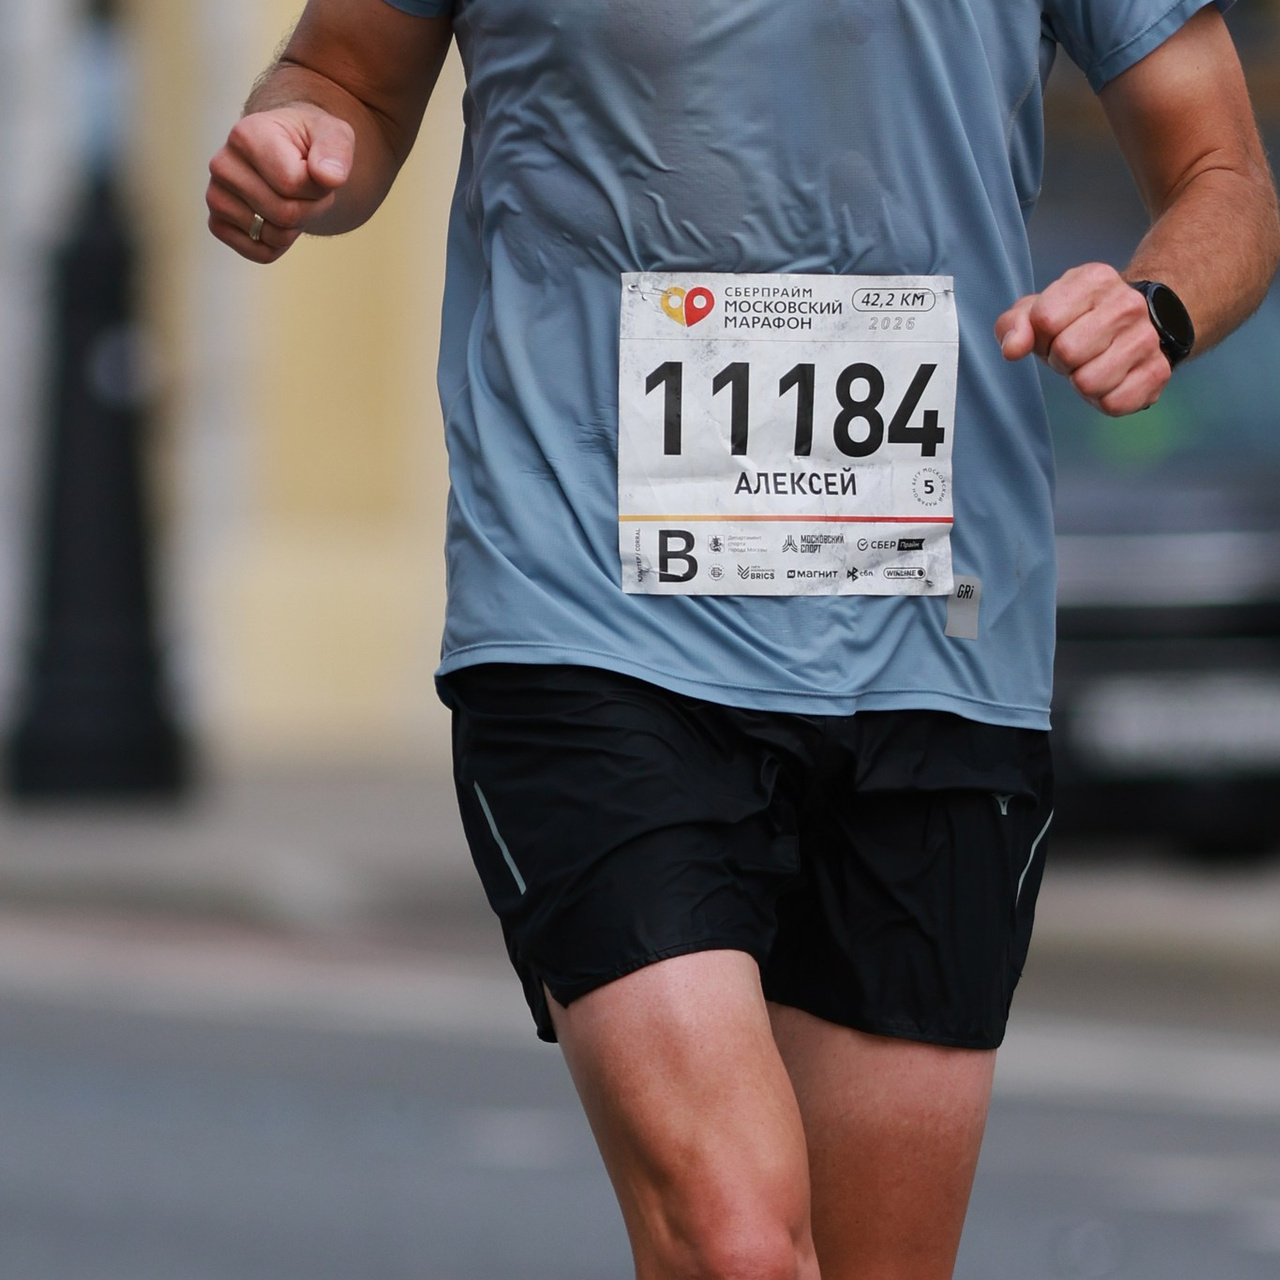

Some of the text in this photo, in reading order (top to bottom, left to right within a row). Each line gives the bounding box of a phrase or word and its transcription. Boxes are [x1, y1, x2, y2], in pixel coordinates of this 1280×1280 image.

[724, 286, 813, 298] СБЕРПРАЙМ
[724, 300, 843, 315] МОСКОВСКИЙ
[861, 293, 926, 308] 42,2 КМ
[724, 316, 812, 330] МАРАФОН
[869, 317, 916, 331] 2026
[645, 361, 945, 458] 11184
[735, 468, 858, 496] АЛЕКСЕЙ
[924, 479, 935, 495] 5
[800, 533, 845, 544] МОСКОВСКИЙ
[871, 540, 896, 550] СБЕР
[659, 529, 699, 583] B
[800, 544, 822, 554] СПОРТ
[797, 570, 839, 579] магнит
[957, 583, 975, 599] GRi
